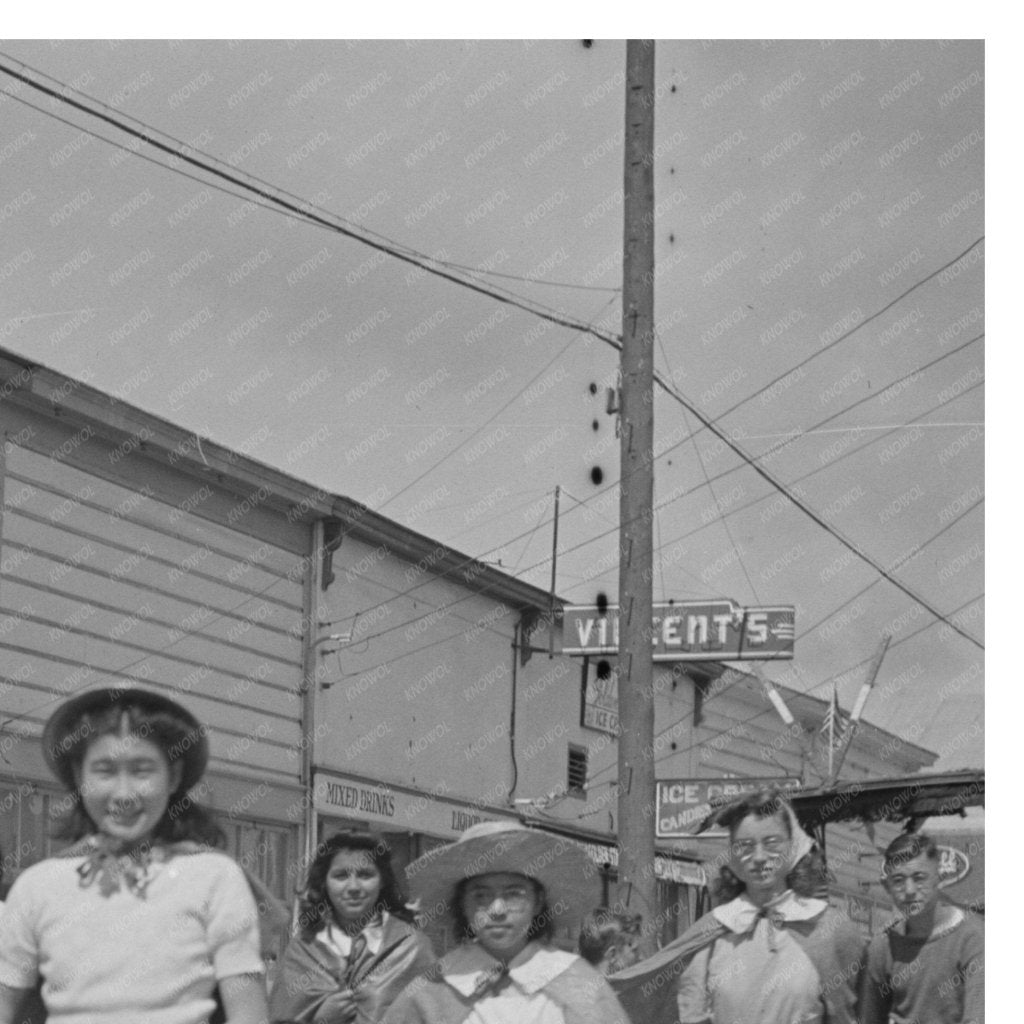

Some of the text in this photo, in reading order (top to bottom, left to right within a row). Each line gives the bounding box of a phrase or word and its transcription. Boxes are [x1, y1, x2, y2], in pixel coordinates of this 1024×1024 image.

[576, 613, 768, 646] VIENT'S
[326, 782, 395, 817] MIXED DRINKS
[662, 784, 699, 804] ICE
